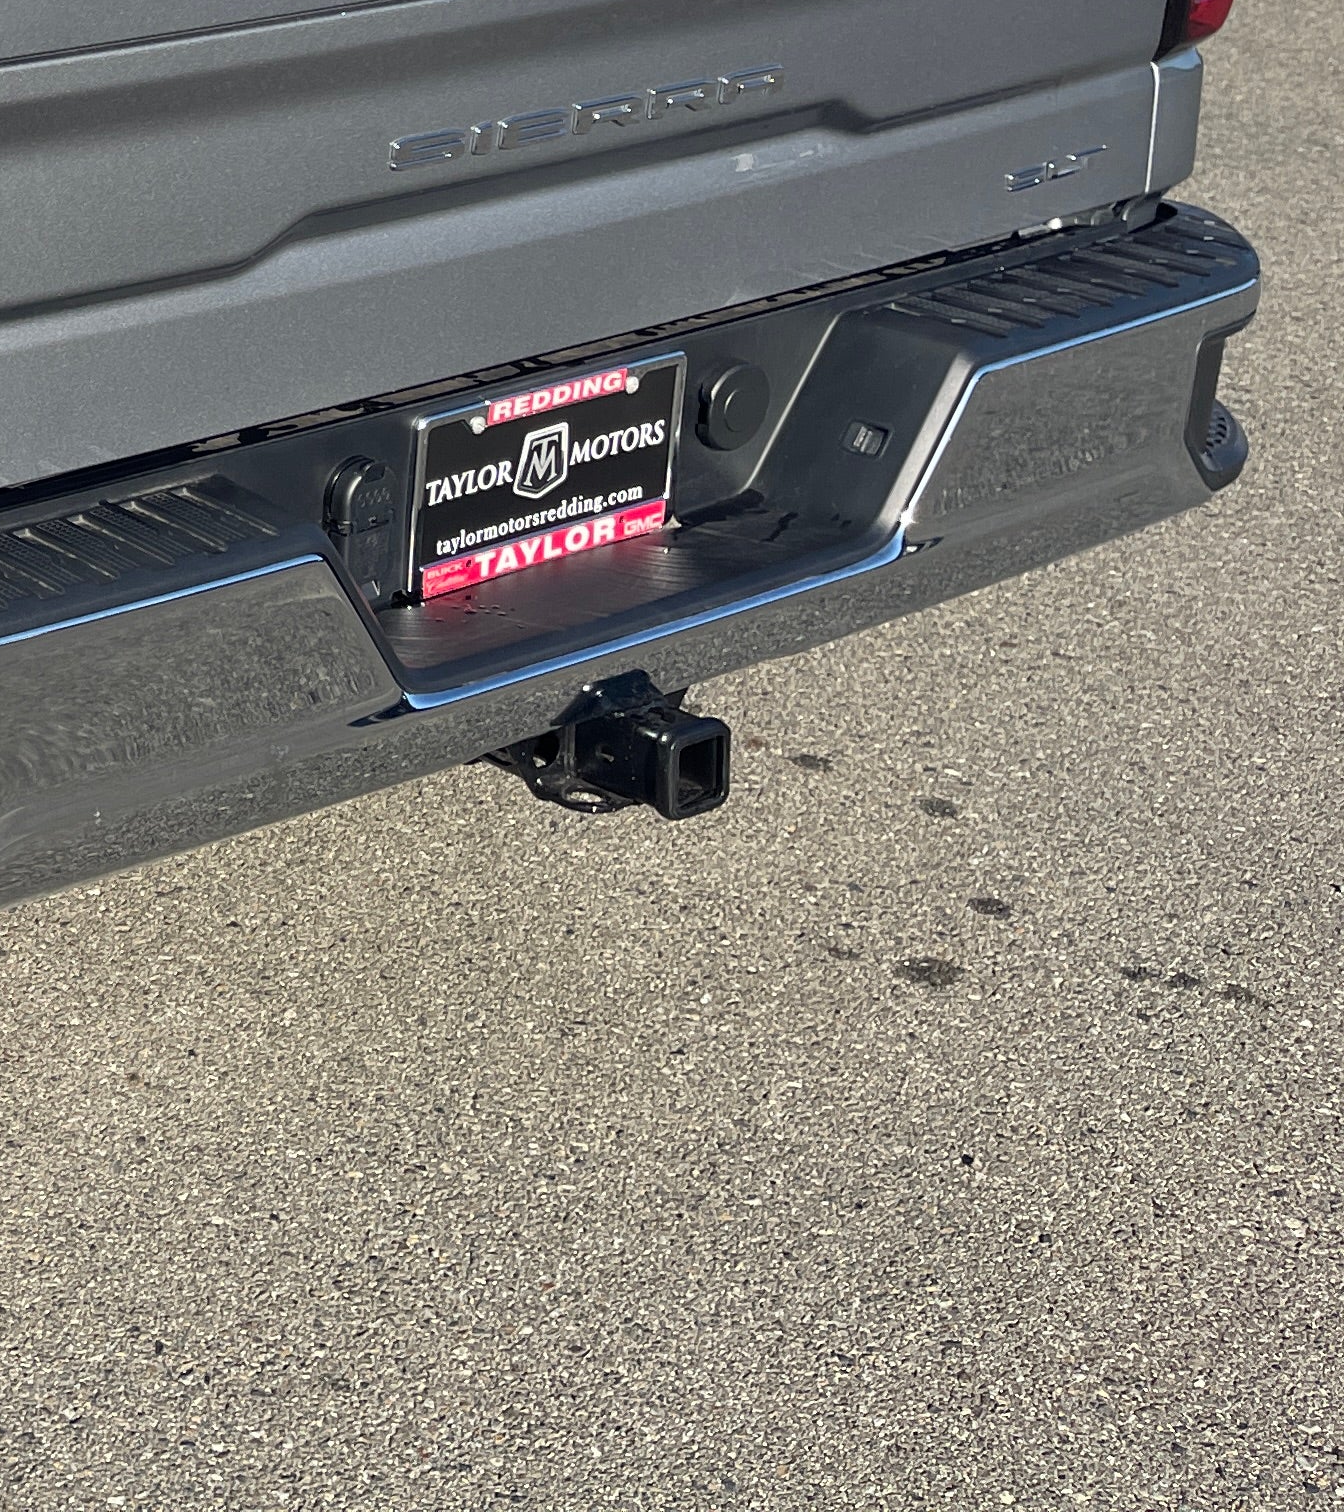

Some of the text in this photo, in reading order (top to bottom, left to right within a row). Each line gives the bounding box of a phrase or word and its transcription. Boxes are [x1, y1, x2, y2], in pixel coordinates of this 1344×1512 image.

[388, 63, 785, 171] SIERRA
[1003, 144, 1109, 193] SLT
[492, 372, 624, 423] REDDING
[425, 460, 514, 507] TAYLOR
[569, 419, 666, 466] MOTORS
[436, 485, 644, 556] taylormotorsredding.com
[474, 516, 617, 579] TAYLOR
[623, 512, 663, 535] GMC
